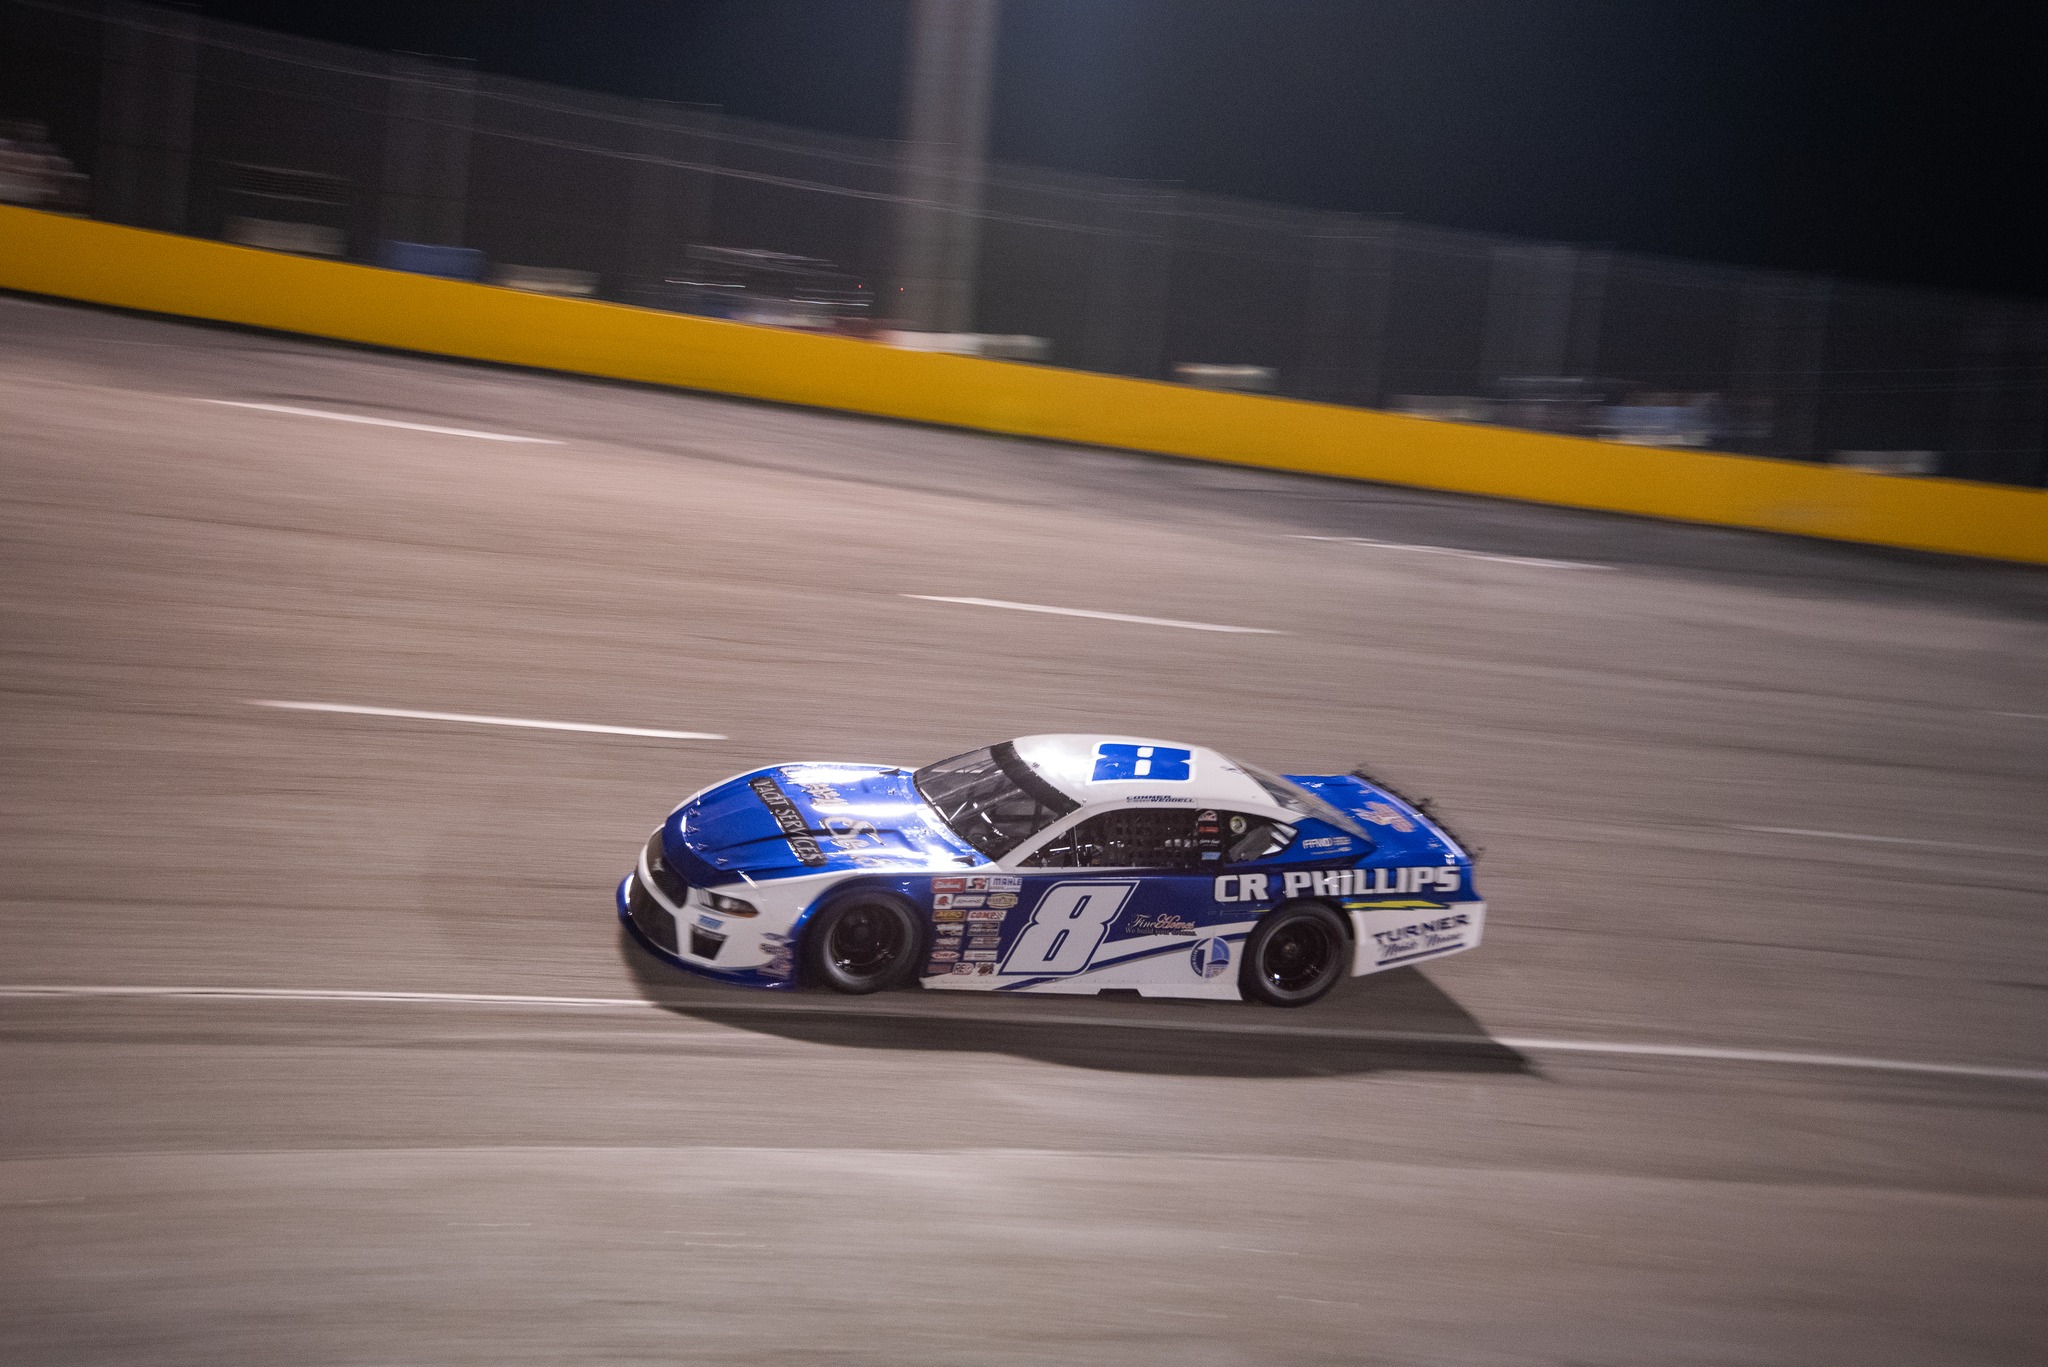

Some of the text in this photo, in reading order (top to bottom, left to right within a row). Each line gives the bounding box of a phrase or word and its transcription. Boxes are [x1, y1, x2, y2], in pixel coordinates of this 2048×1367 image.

[1090, 743, 1191, 781] 8
[775, 808, 823, 862] SERVICES
[993, 878, 1022, 886] MAHLE
[1214, 866, 1461, 902] CR PHILLIPS
[998, 880, 1141, 976] 8
[1374, 914, 1469, 945] TURNER
